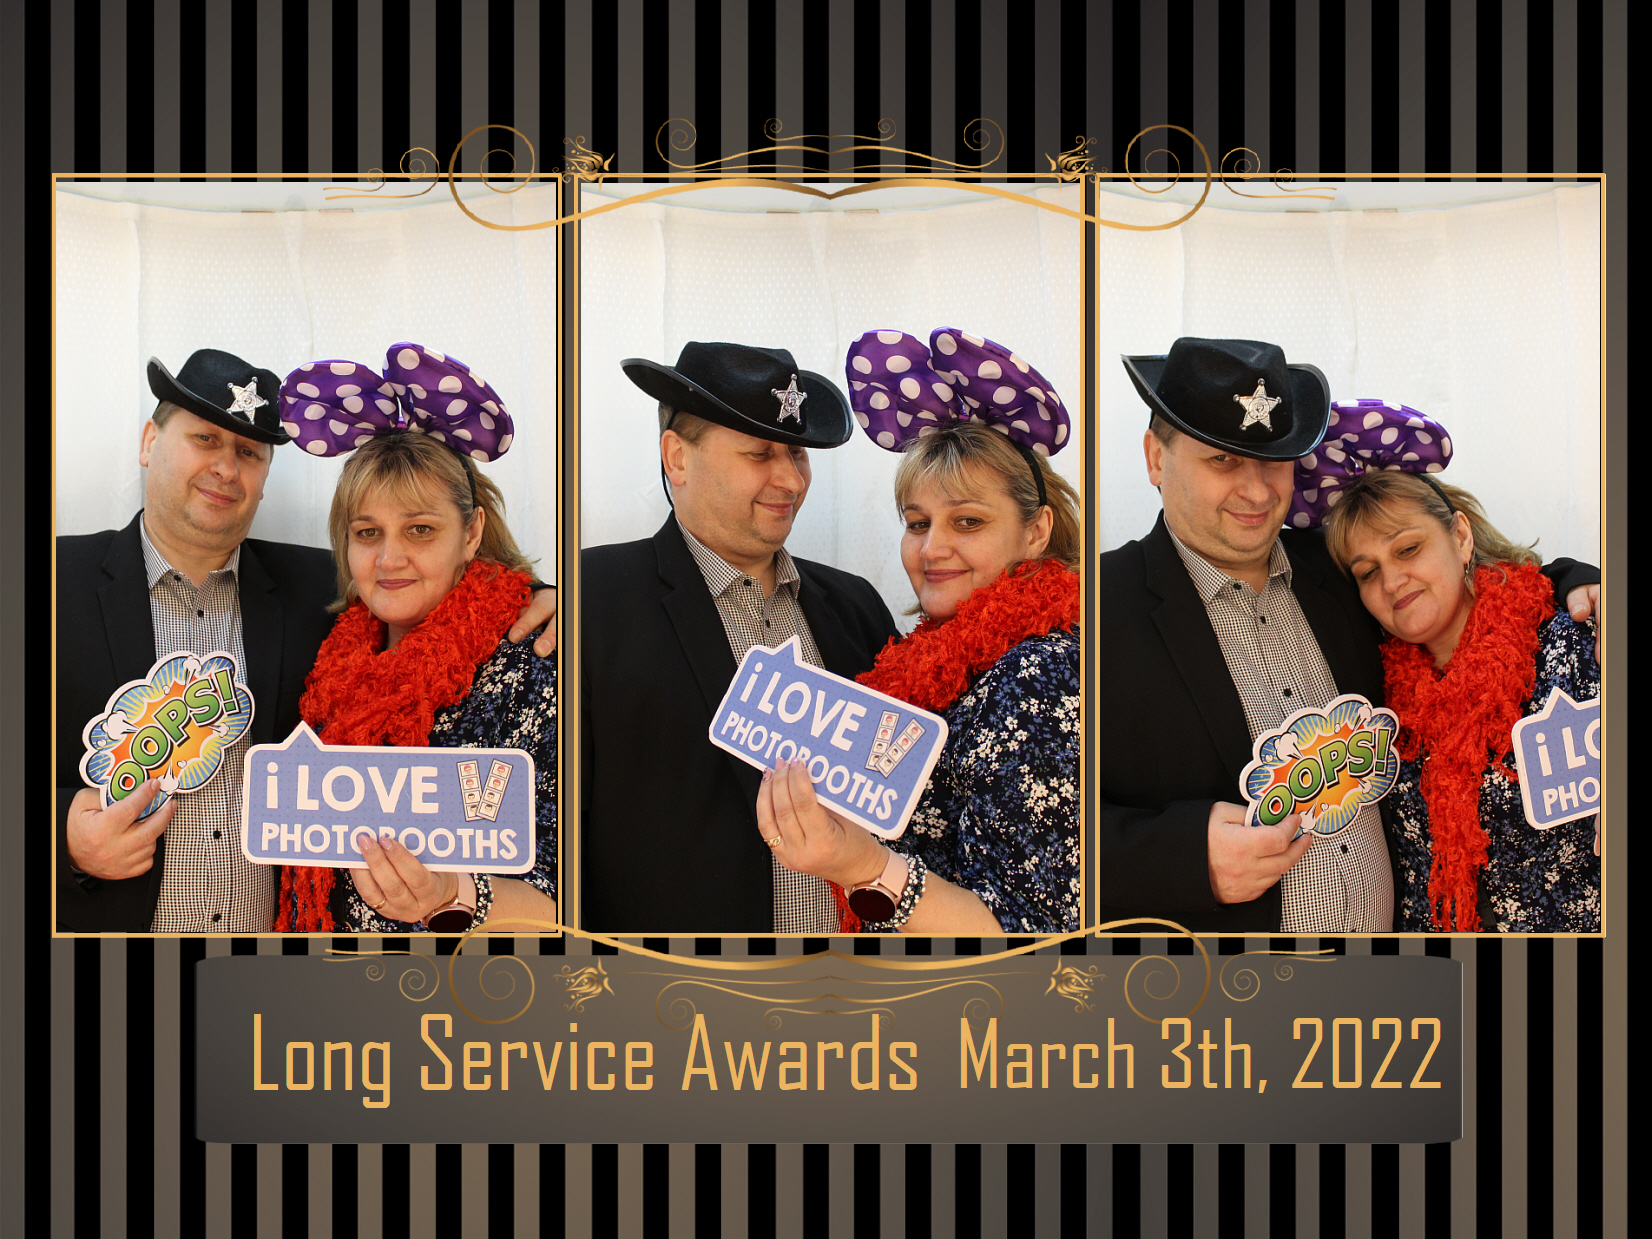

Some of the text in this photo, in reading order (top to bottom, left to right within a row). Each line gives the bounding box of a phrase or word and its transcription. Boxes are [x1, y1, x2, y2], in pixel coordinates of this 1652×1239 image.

[108, 669, 240, 802] OOPS!
[740, 662, 867, 751] i LOVE
[265, 762, 439, 814] i LOVE
[1257, 729, 1391, 826] OOPS!
[1535, 732, 1552, 777] i
